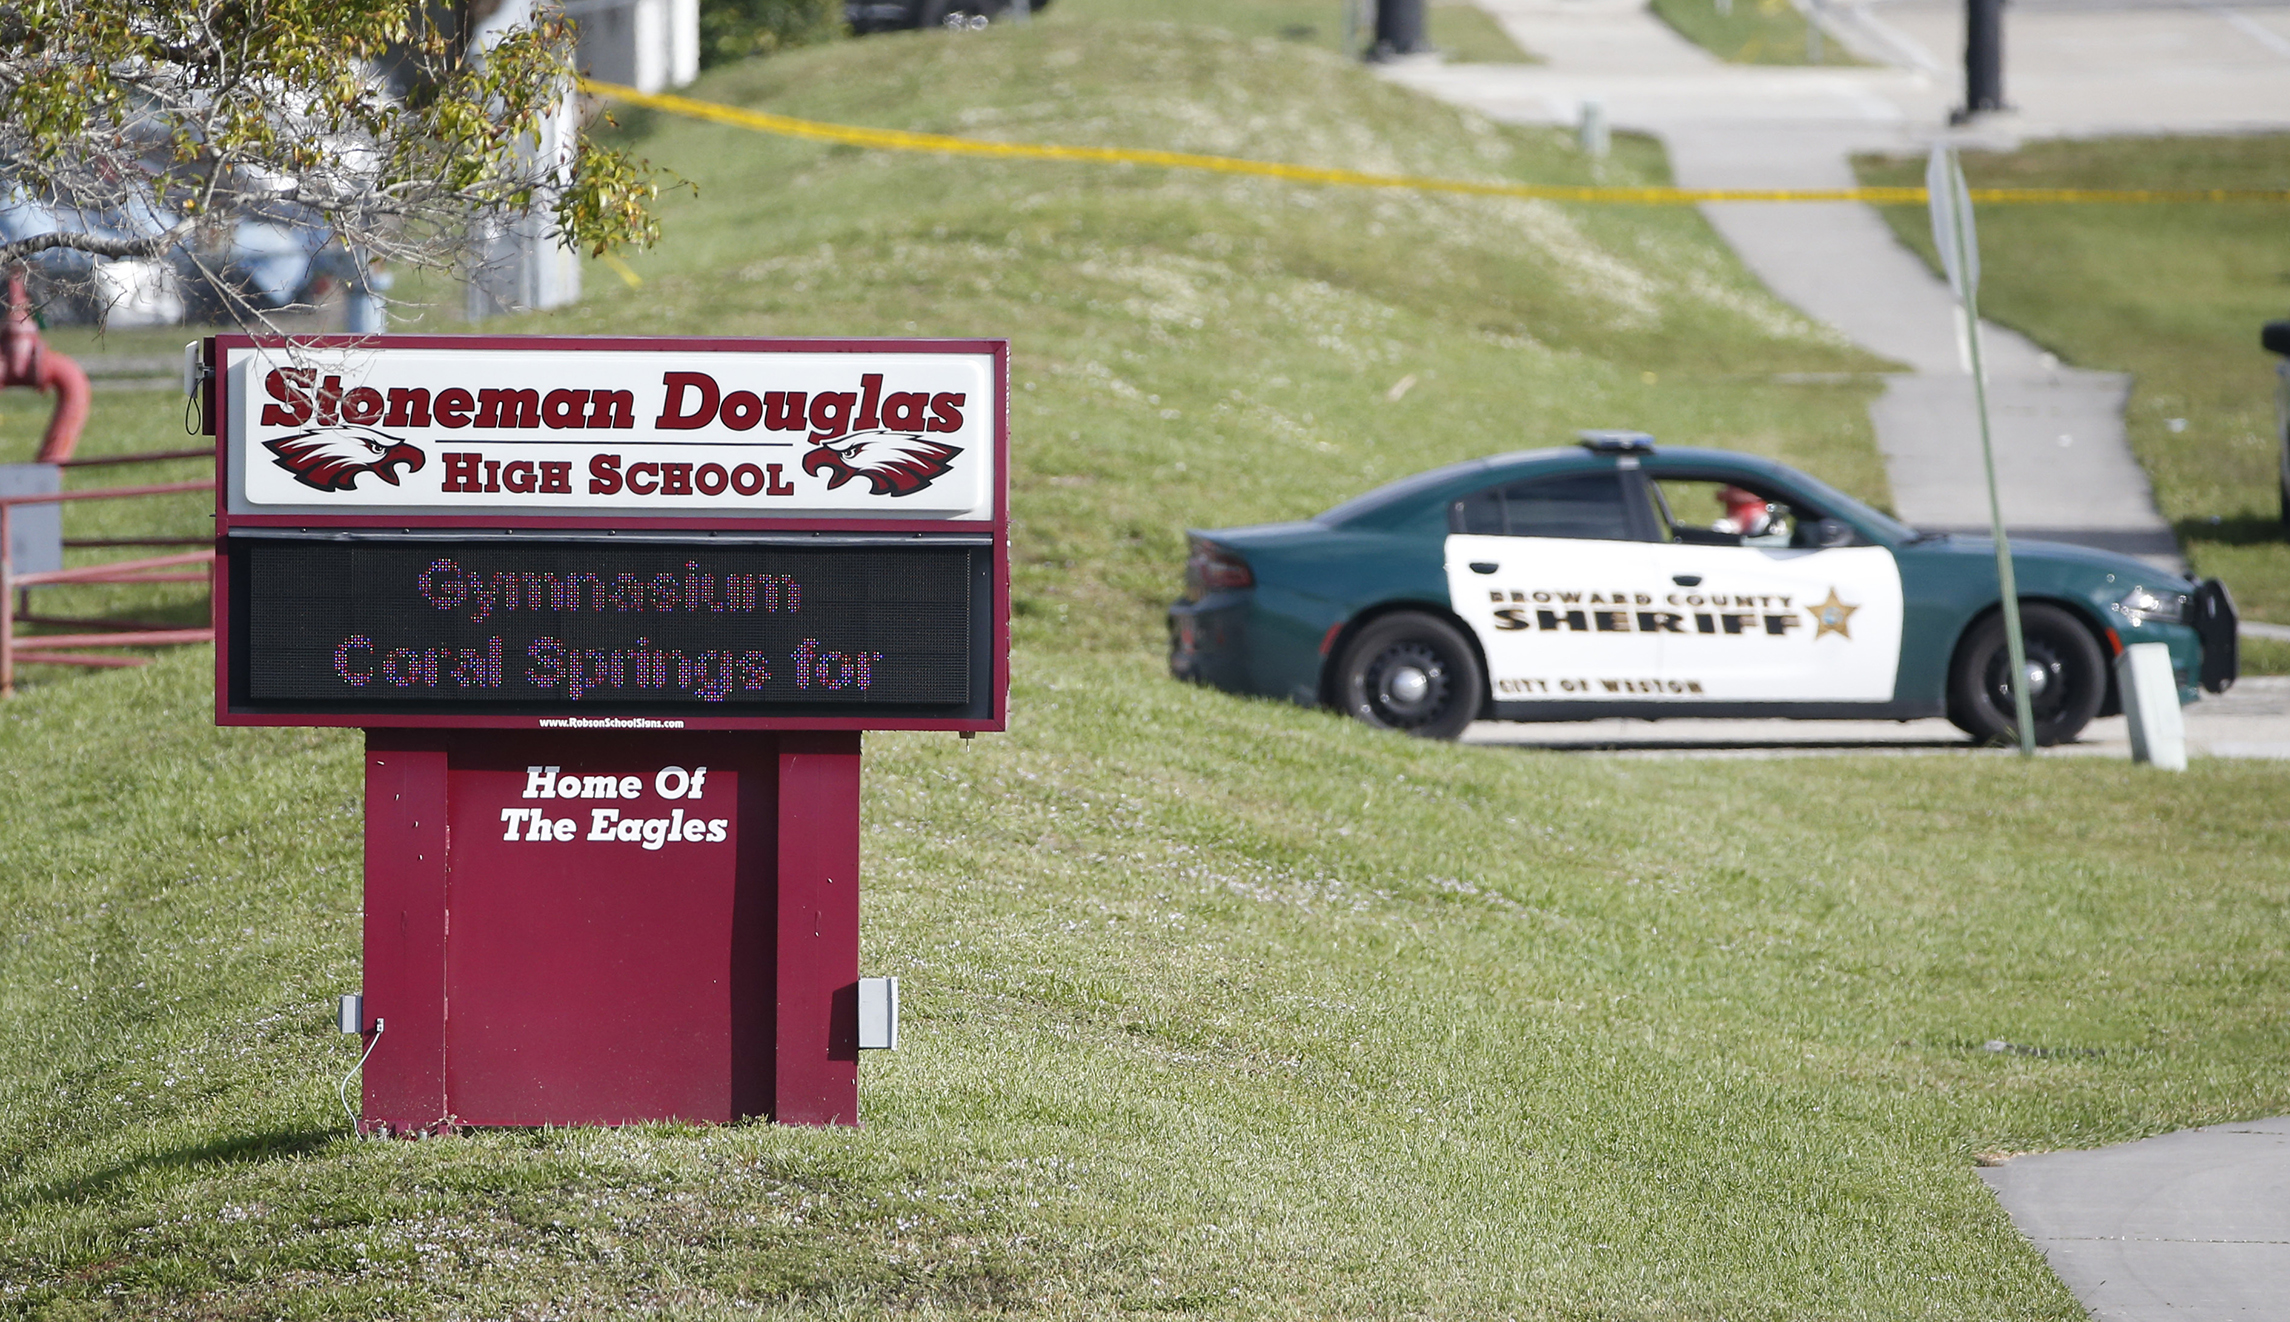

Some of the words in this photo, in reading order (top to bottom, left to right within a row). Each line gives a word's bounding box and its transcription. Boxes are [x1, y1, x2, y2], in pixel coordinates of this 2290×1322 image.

[260, 368, 635, 430] Stoneman
[654, 371, 967, 439] Douglas
[441, 452, 574, 496] HIGH
[589, 453, 796, 498] SCHOOL
[418, 557, 802, 624] Gymnasium
[1489, 591, 1653, 606] BROWARD
[1667, 594, 1792, 608] COUNTY
[1493, 609, 1802, 637] SHERIFF
[334, 634, 503, 689] Coral
[527, 637, 773, 703] Springs
[791, 638, 884, 692] for
[1499, 679, 1550, 693] CITY
[1559, 679, 1590, 693] OF
[1600, 679, 1705, 694] WESTON
[539, 717, 685, 730] www.RobsonSchoolSigns.com
[522, 766, 644, 800] Home
[655, 765, 708, 800] Of
[500, 807, 578, 843] The
[586, 808, 729, 851] Eagles
